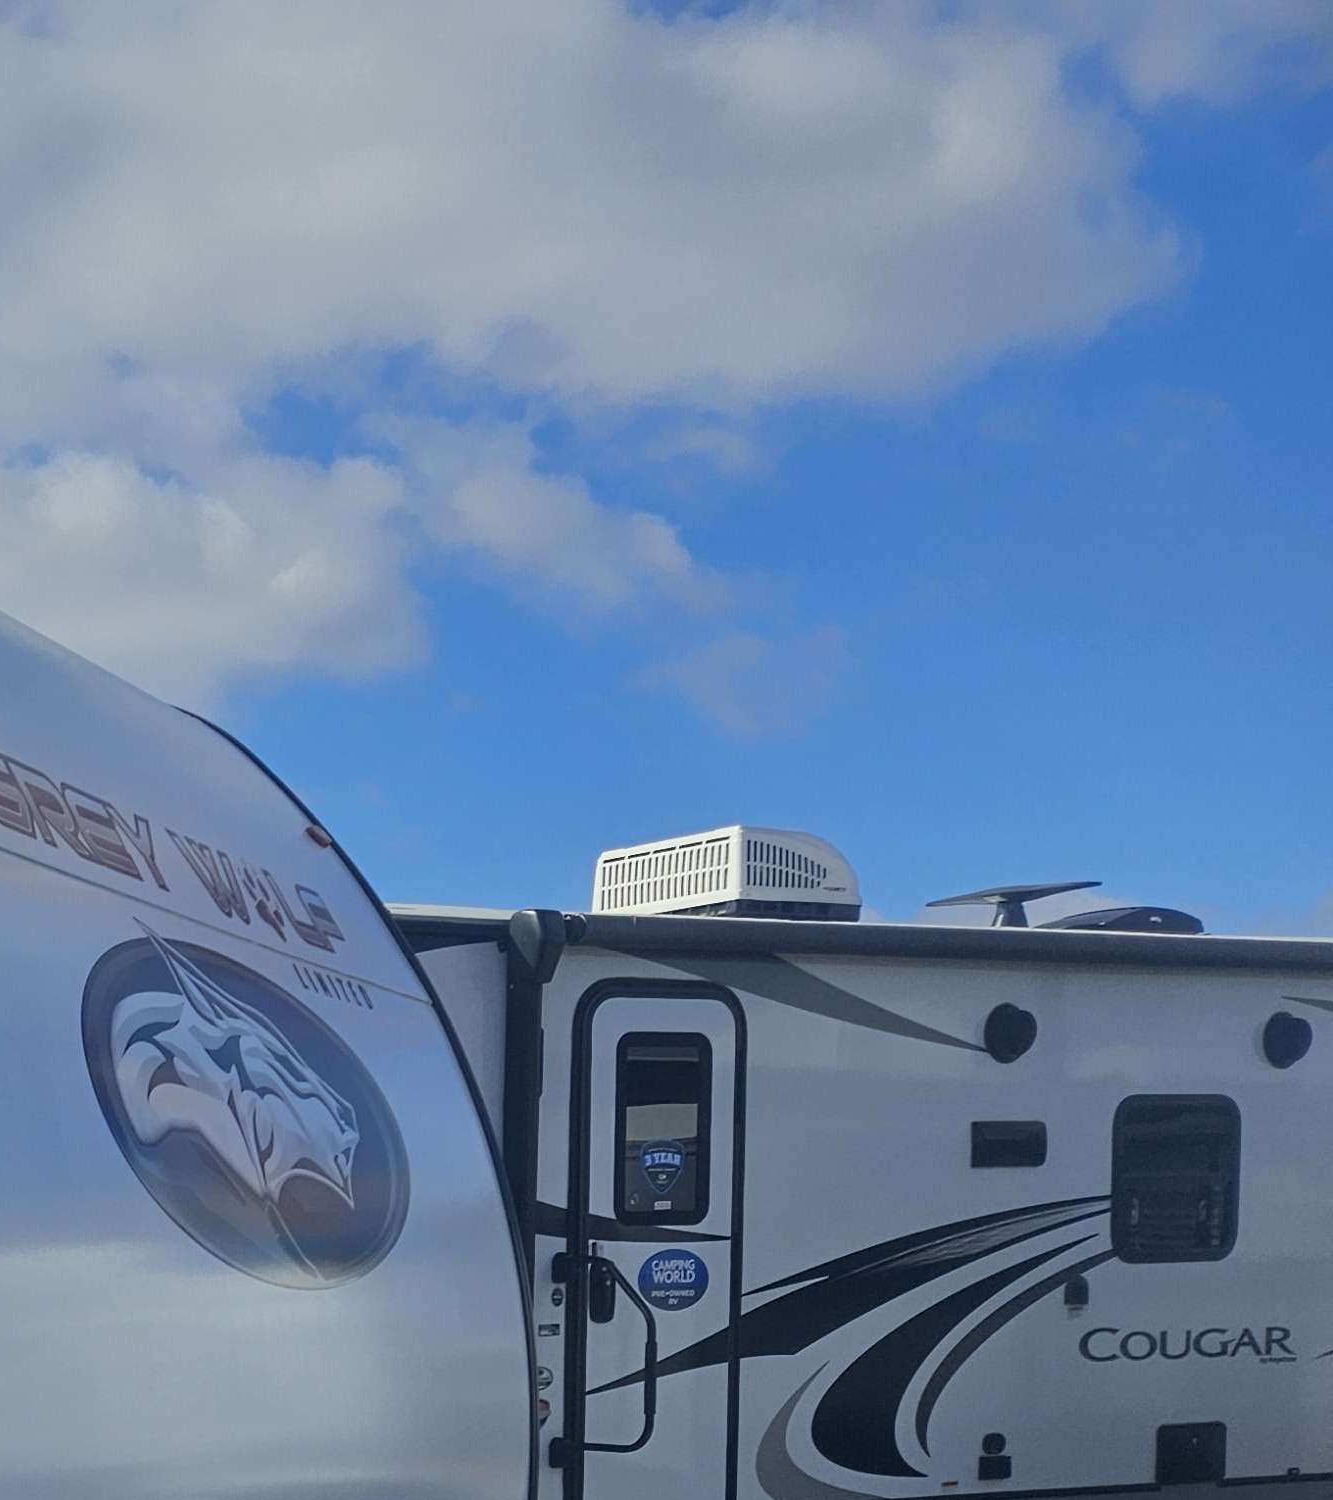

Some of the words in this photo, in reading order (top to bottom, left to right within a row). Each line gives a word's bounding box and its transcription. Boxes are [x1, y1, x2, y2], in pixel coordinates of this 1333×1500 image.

[292, 964, 374, 1010] LIMITED
[653, 1152, 681, 1166] YEAR
[651, 1259, 695, 1271] CAMPING
[653, 1270, 695, 1284] WORLD
[1079, 1327, 1297, 1363] COUGAR
